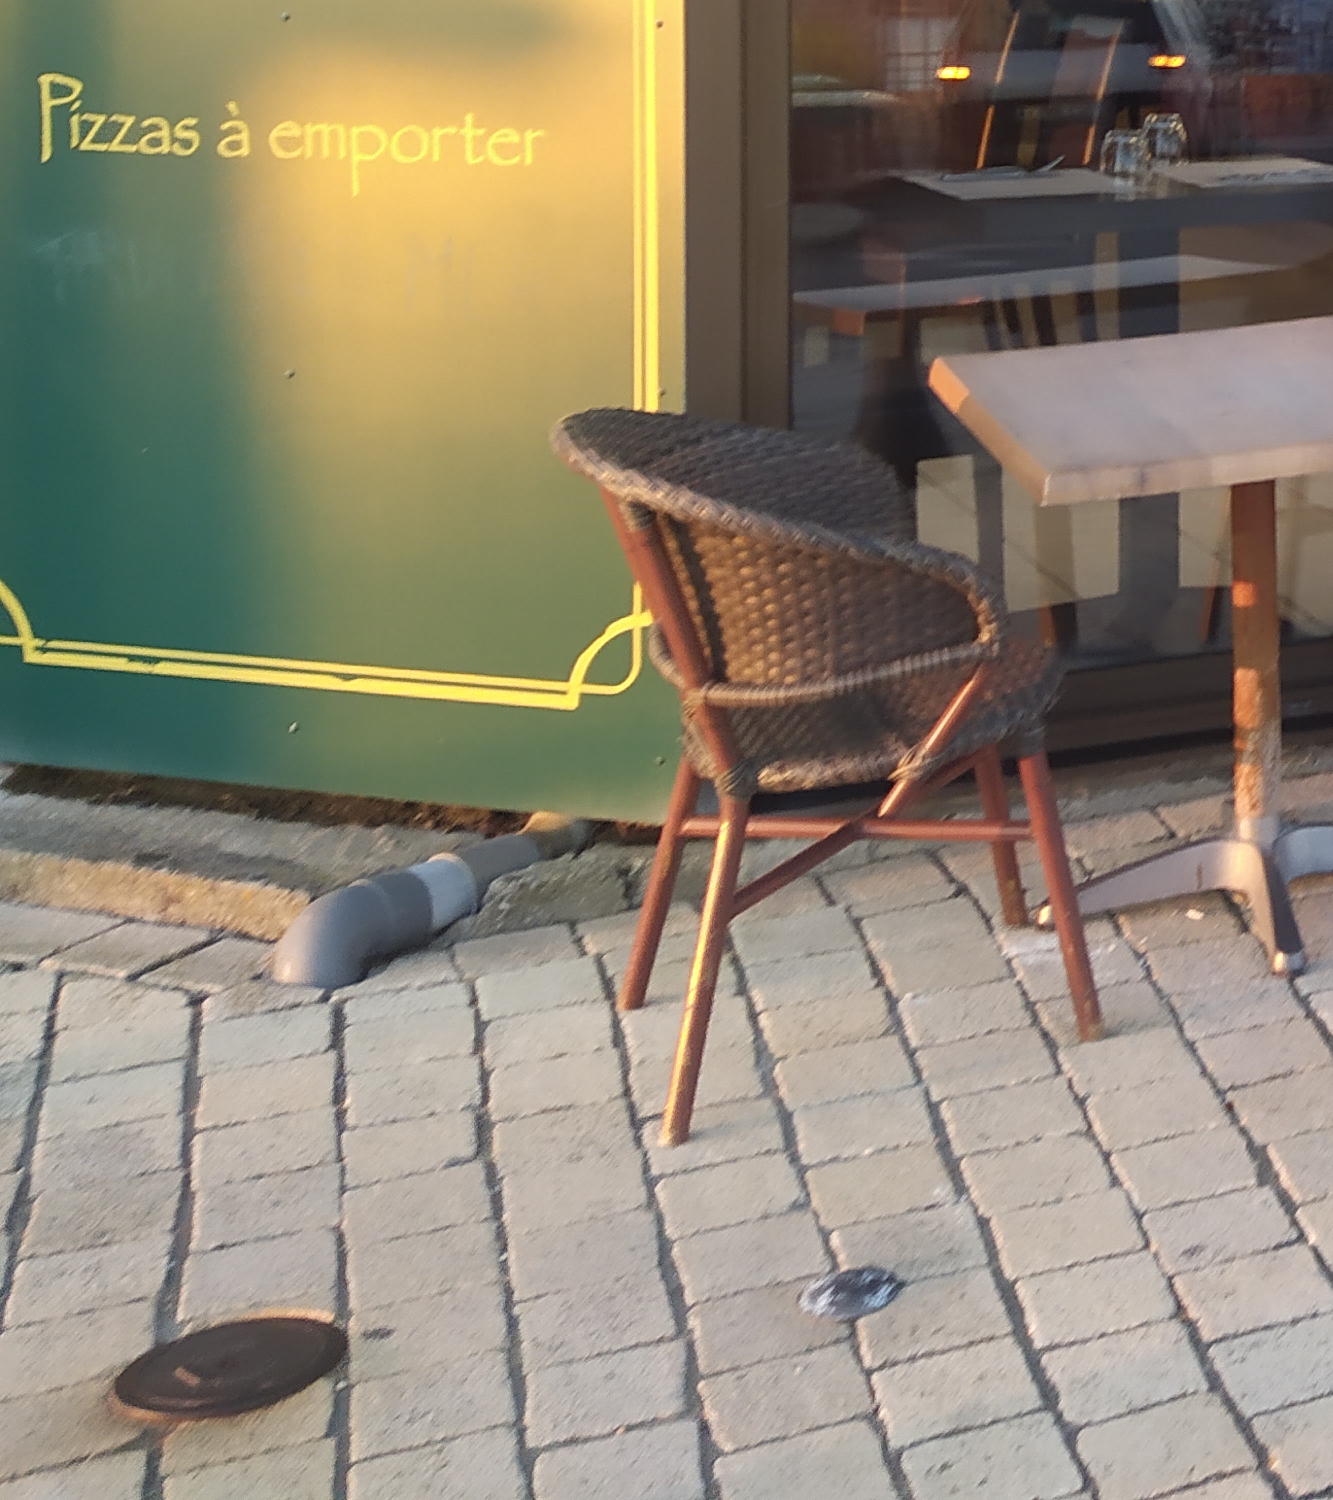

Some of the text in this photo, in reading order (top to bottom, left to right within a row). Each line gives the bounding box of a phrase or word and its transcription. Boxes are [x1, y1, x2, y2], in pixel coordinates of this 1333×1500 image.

[37, 71, 546, 198] Pizzas à emporter
